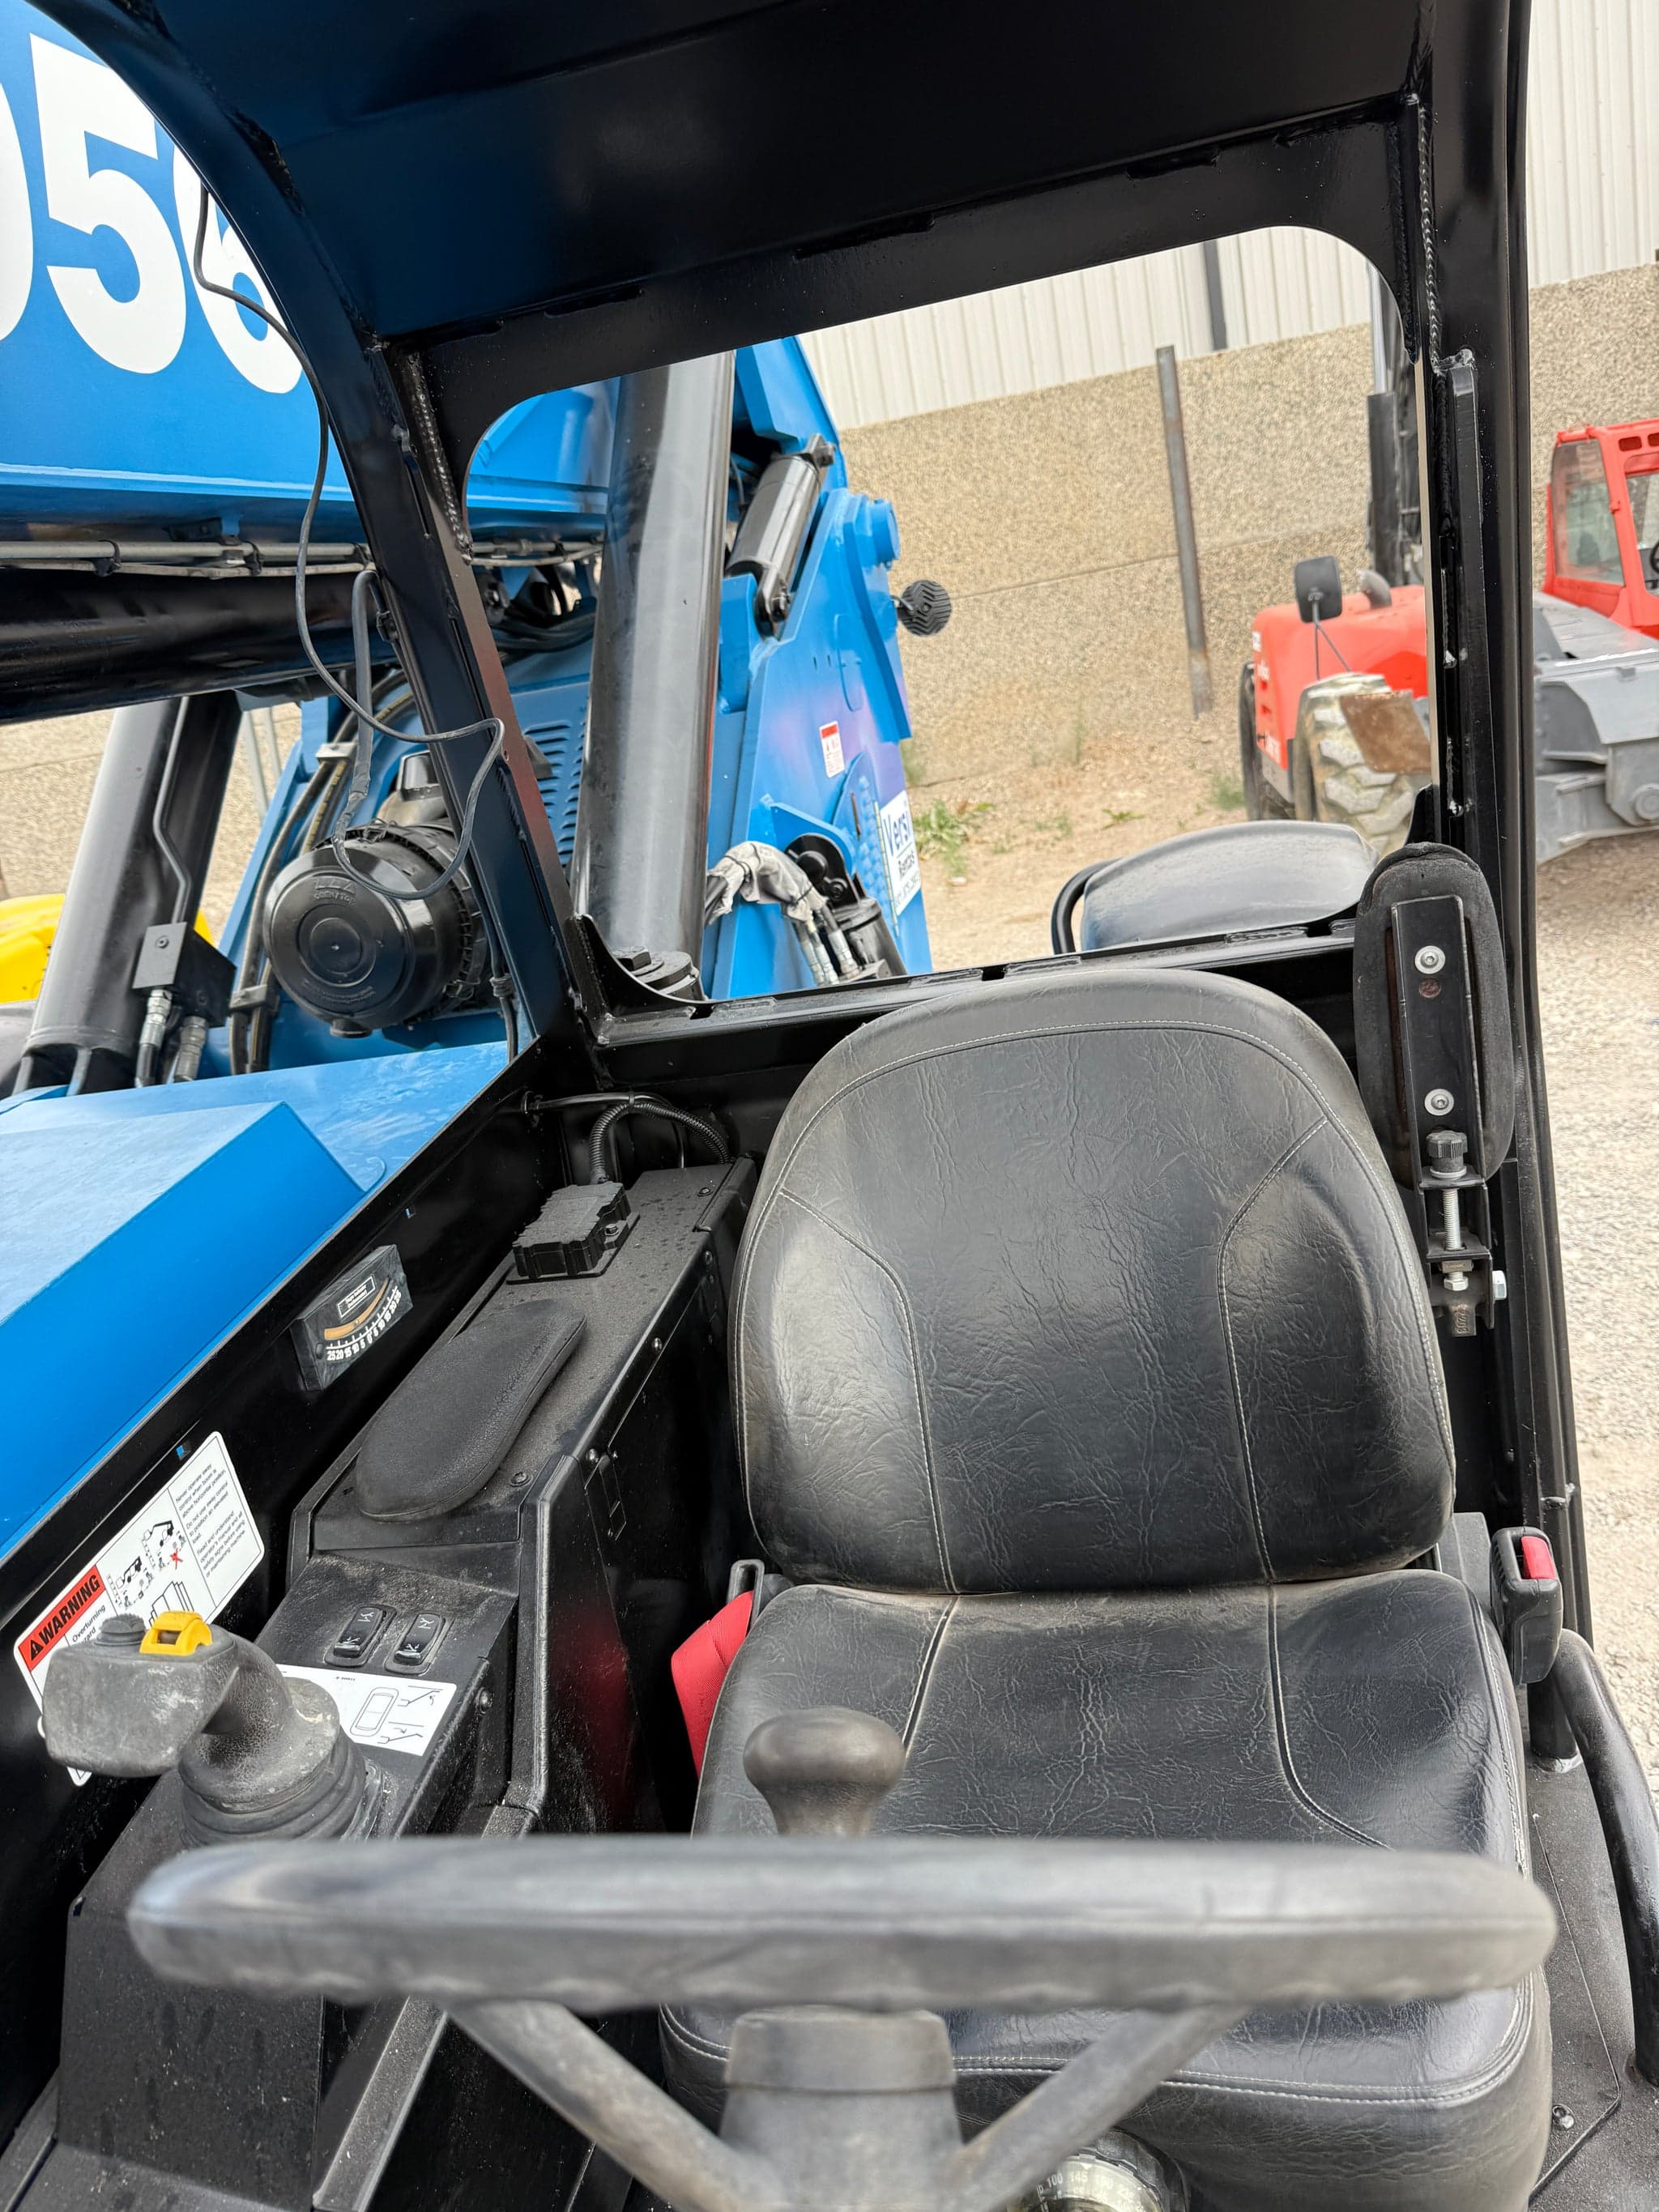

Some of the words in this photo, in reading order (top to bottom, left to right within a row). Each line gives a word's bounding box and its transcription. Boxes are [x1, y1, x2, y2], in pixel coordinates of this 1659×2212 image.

[0, 32, 303, 394] 56
[327, 1349, 335, 1361] 25
[335, 1349, 344, 1360] 20
[344, 1346, 352, 1357] 15
[352, 1342, 359, 1354] 10
[360, 1338, 365, 1349] 5
[373, 1327, 378, 1336] 5
[377, 1319, 386, 1330] 10
[384, 1310, 392, 1322] 15
[389, 1300, 397, 1314] 20
[394, 1289, 402, 1304] 25
[179, 1494, 192, 1511] control
[182, 1504, 194, 1519] above
[194, 1484, 211, 1505] horizontal
[215, 1480, 228, 1497] control
[194, 1515, 208, 1532] position
[197, 1541, 207, 1555] Read
[215, 1511, 234, 1536] understand
[211, 1547, 231, 1572] maintaining
[38, 1574, 100, 1643] WARNING
[72, 1605, 105, 1643] Overturning
[1047, 2172, 1063, 2188] 100
[1069, 2171, 1088, 2183] 145
